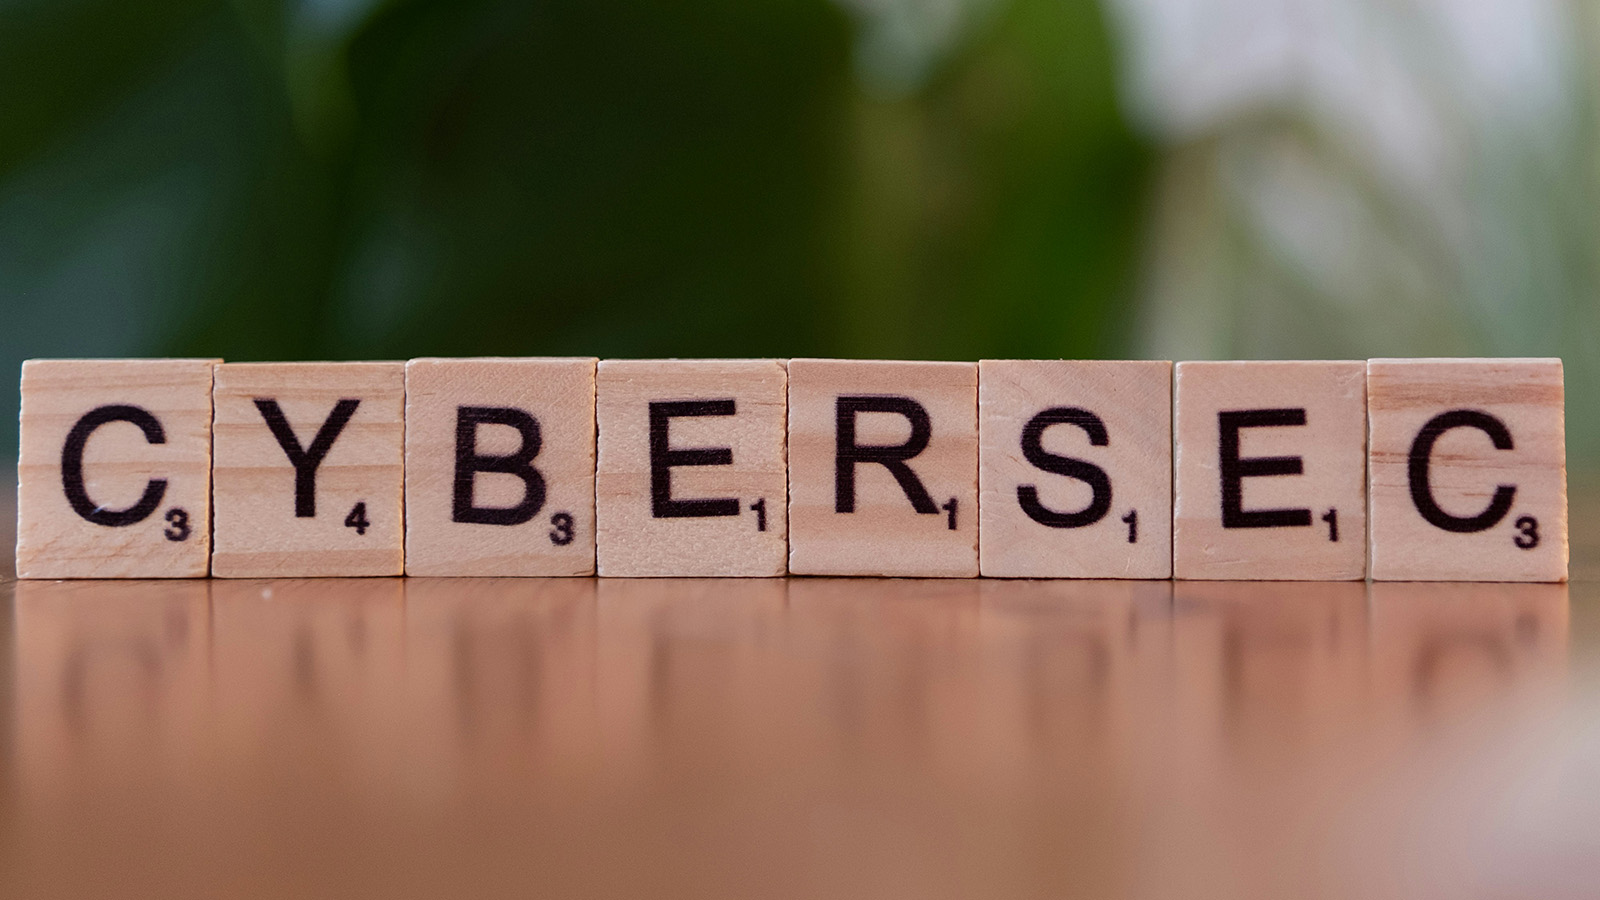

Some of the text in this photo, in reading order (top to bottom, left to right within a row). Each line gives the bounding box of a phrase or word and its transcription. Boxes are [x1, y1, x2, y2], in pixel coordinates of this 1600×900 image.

[60, 395, 1518, 534] CYBERSEC
[165, 508, 191, 542] 3
[344, 502, 371, 535] 4
[549, 512, 575, 546] 3
[749, 497, 767, 532] 1
[941, 497, 960, 531] 1
[1121, 509, 1138, 544] 1
[1321, 508, 1340, 543] 1
[1513, 515, 1540, 550] 3
